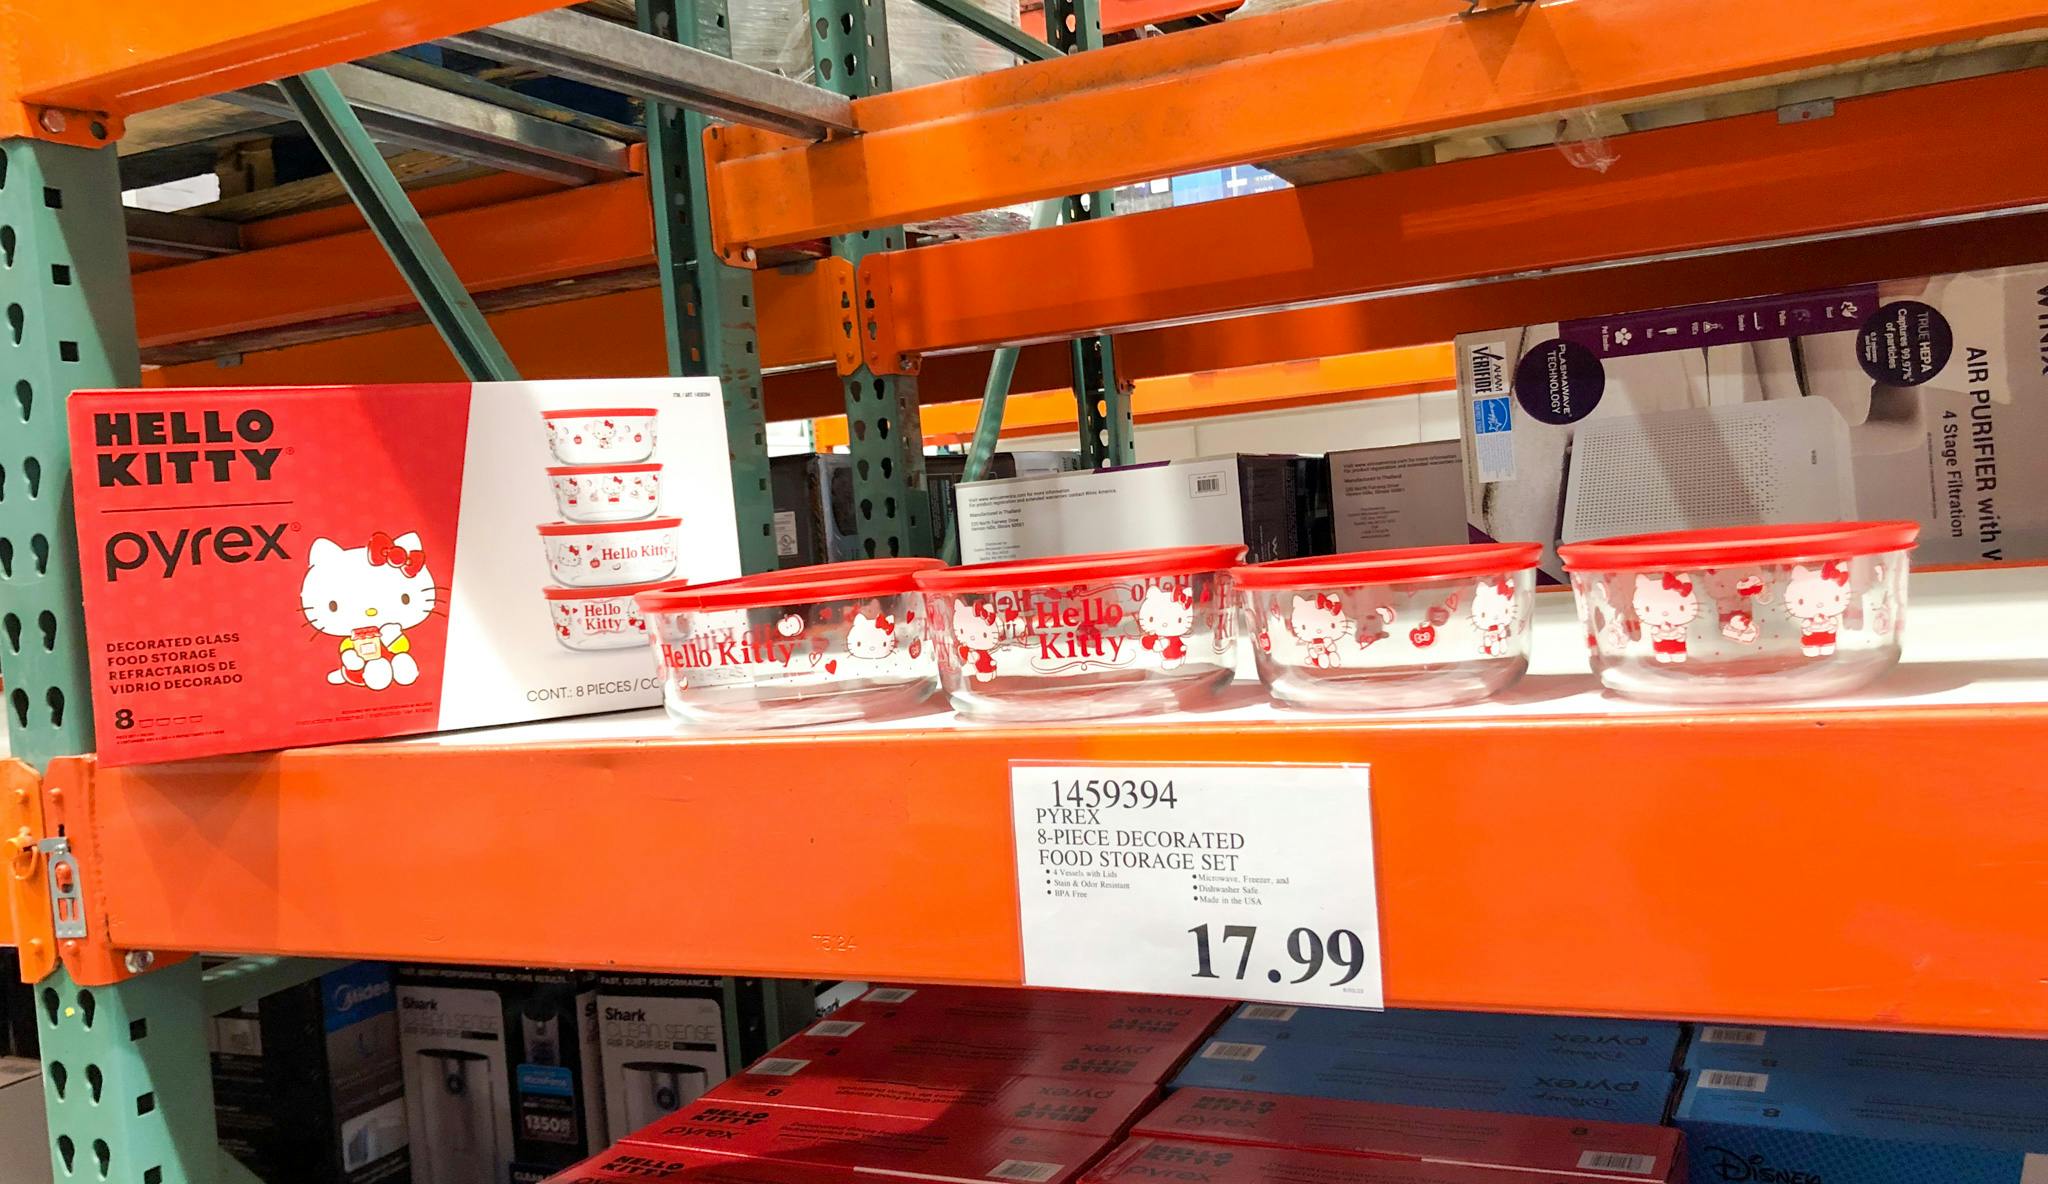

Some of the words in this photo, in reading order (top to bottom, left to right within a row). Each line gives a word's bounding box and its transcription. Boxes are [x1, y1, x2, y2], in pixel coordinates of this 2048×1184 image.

[1885, 322, 1897, 332] of
[1896, 308, 1908, 347] Captures
[1917, 312, 1931, 340] TRUE
[1884, 332, 1898, 369] particles
[1919, 341, 1933, 373] HEPA
[1966, 347, 1990, 384] AIR
[1493, 363, 1503, 392] AHAM
[1547, 351, 1561, 414] TECHNOLOGY
[1558, 344, 1571, 415] PLASMAWAVE
[1942, 410, 1957, 419] 4
[94, 409, 274, 447] HELLO
[1941, 424, 1958, 466] Stage
[1969, 390, 1997, 492] PURIFIER
[97, 448, 284, 487] KITTY
[1947, 471, 1966, 538] Filtration
[1978, 498, 2002, 543] with
[105, 523, 292, 582] pyrex
[602, 547, 638, 562] Hello
[641, 543, 671, 559] Kitty
[584, 602, 621, 617] Hello
[1036, 597, 1124, 629] Hello
[586, 617, 622, 632] Kitty
[106, 637, 192, 653] DECORATED
[195, 633, 240, 645] GLASS
[1039, 631, 1127, 662] Kitty
[107, 654, 148, 667] FOOD
[151, 648, 217, 663] STORAGE
[660, 643, 712, 668] Hello
[718, 640, 795, 668] Kitty
[109, 662, 216, 681] REFRACTARIOS
[219, 660, 237, 671] DE
[110, 681, 161, 695] VIDRIO
[164, 673, 243, 690] DECORADO
[576, 684, 585, 697] 8
[587, 680, 631, 695] PIECES
[115, 708, 135, 730] 8
[1051, 779, 1178, 810] 1459394
[1036, 808, 1101, 825] PYREX
[1038, 828, 1110, 847] 8-PIECE
[1116, 830, 1244, 851] DECORATED
[1039, 849, 1094, 867] FOOD
[1100, 851, 1194, 870] STORAGE
[1201, 854, 1239, 872] SET
[1060, 869, 1084, 877] Vessels
[1087, 870, 1101, 878] with
[1276, 876, 1290, 884] and
[1054, 879, 1071, 887] Stain
[1100, 881, 1130, 889] Resistant
[1199, 884, 1240, 893] Dishwasher
[1242, 886, 1258, 894] Safe
[1072, 890, 1088, 898] Free
[1200, 895, 1219, 904] Made
[1221, 896, 1229, 904] in
[1244, 897, 1263, 905] USA
[1187, 922, 1365, 987] 17.99
[402, 996, 438, 1011] Shark
[605, 1007, 646, 1022] Shark
[607, 1021, 662, 1039] CLEAN
[665, 1023, 716, 1041] SENSE
[1552, 1034, 1649, 1046] pyrex
[606, 1039, 623, 1048] AIR
[625, 1040, 672, 1050] PURIFIER
[1079, 1044, 1153, 1056] pyrex
[1039, 1086, 1115, 1100] pyrex
[1535, 1077, 1639, 1091] pyrex
[690, 1114, 763, 1126] KITTY
[702, 1107, 770, 1119] HELLO
[525, 1114, 560, 1132] 1350
[662, 1126, 743, 1141] pyrex
[599, 1162, 673, 1178] KITTY
[614, 1155, 685, 1170] HELLO
[1122, 1165, 1210, 1182] pyrex
